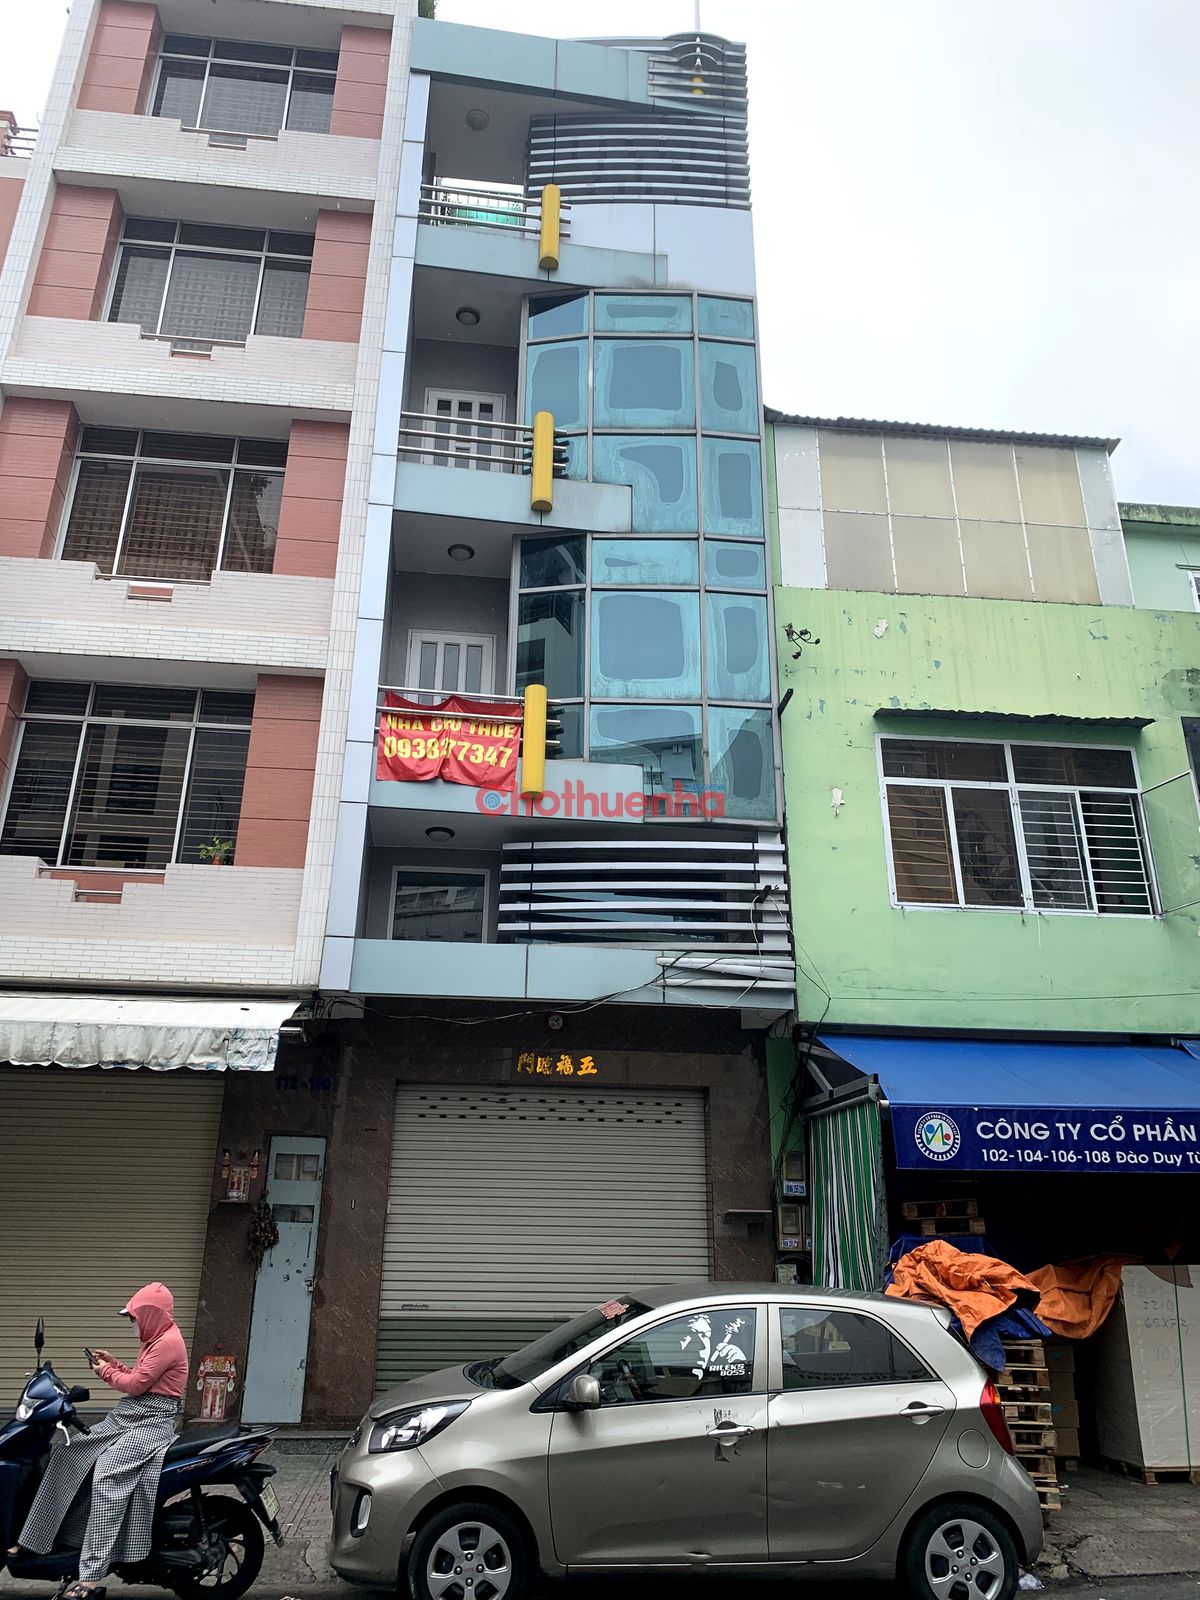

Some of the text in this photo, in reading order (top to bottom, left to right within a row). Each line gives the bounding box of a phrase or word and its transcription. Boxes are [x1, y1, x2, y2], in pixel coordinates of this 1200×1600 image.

[976, 1118, 1050, 1140] CÔNG
[1055, 1123, 1081, 1140] TY
[1089, 1115, 1126, 1141] CỔ
[1132, 1117, 1197, 1141] PHẦN
[982, 1149, 1111, 1164] 102-104-106-108
[1116, 1150, 1149, 1164] Đào
[1153, 1152, 1182, 1167] Duy
[720, 1369, 745, 1377] BOSS
